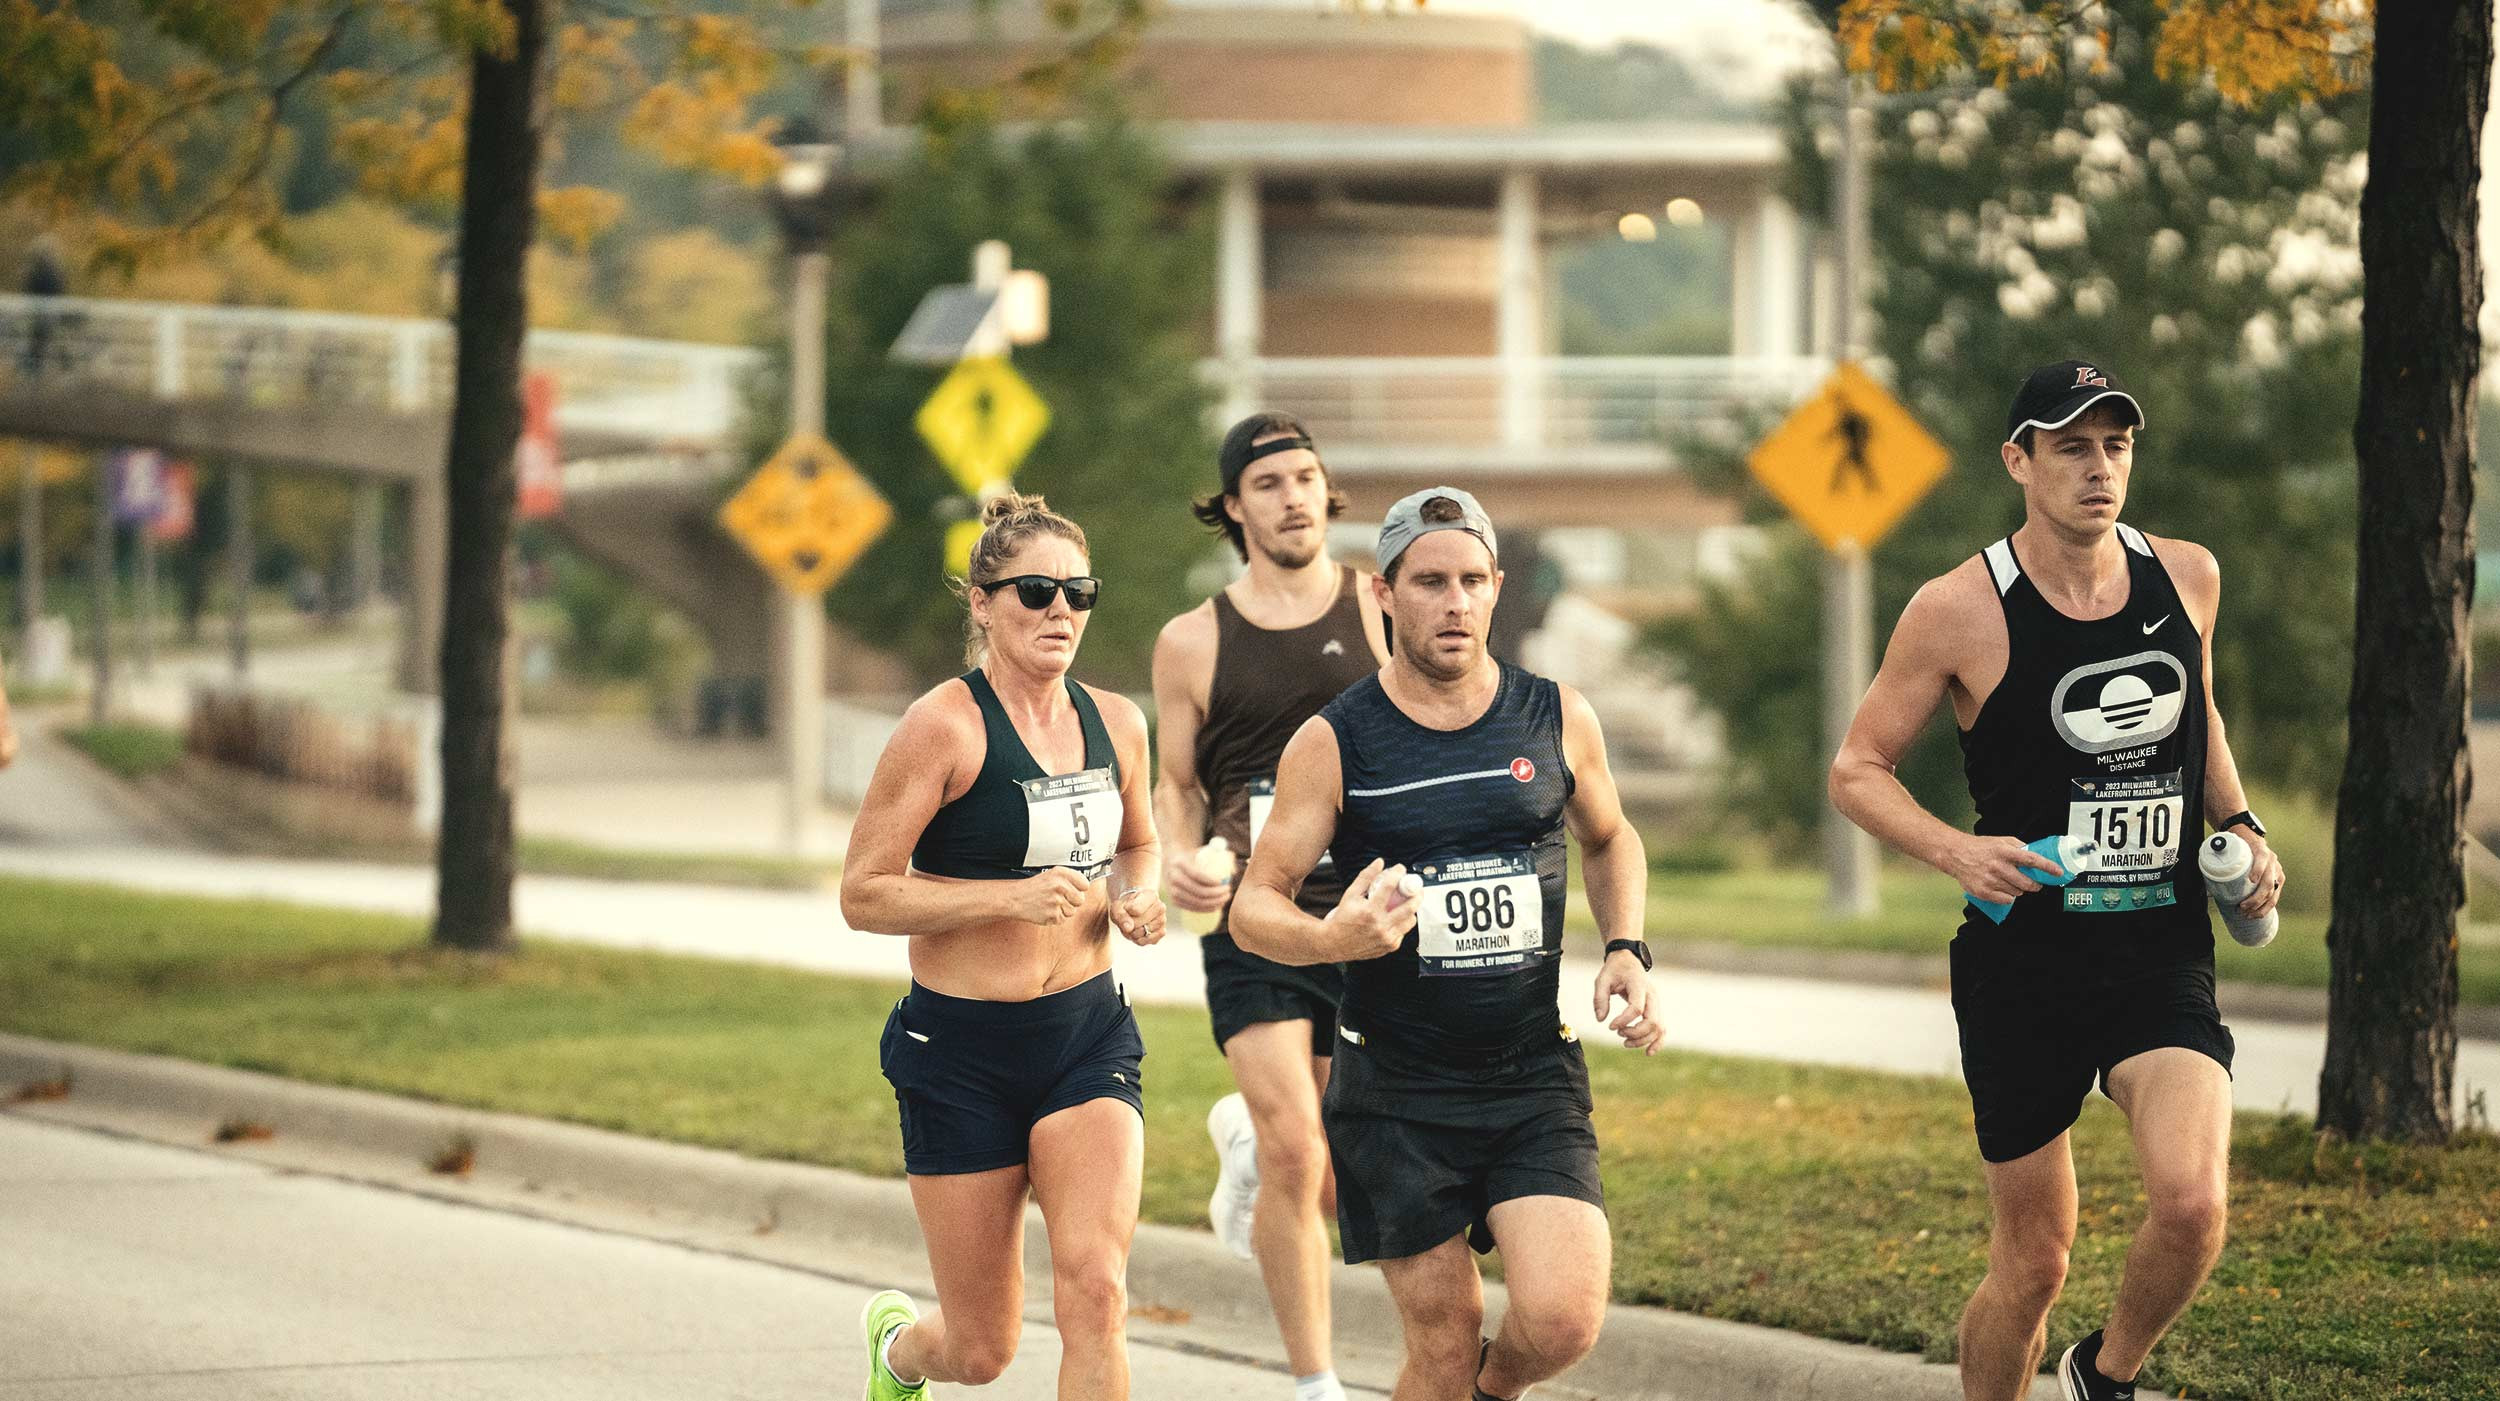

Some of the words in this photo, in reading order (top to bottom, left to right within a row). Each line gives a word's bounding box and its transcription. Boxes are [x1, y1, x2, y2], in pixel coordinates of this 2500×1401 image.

[2097, 746, 2158, 765] MILWAUKEE
[2109, 759, 2146, 772] DISTANCE
[2105, 782, 2120, 790] 2023
[2121, 780, 2157, 789] MILWAUKEE
[2095, 790, 2132, 798] LAKEFRONT
[2132, 788, 2164, 797] MARATHON
[1070, 802, 1090, 846] 5
[2090, 803, 2171, 850] 1510
[1069, 849, 1093, 862] ELITE
[2101, 853, 2153, 867] MARATHON
[1446, 863, 1463, 872] 2023
[1463, 858, 1502, 870] MILWAUKEE
[1438, 869, 1475, 881] LAKEFRONT
[1475, 866, 1512, 877] MARATHON
[2100, 875, 2129, 883] RUNNERS,
[2129, 874, 2137, 882] BY
[2068, 893, 2093, 905] BEER
[1445, 884, 1515, 934] 986
[1455, 935, 1511, 952] MARATHON
[1442, 960, 1454, 968] FOR
[1455, 958, 1486, 969] RUNNERS,
[1486, 957, 1495, 966] BY
